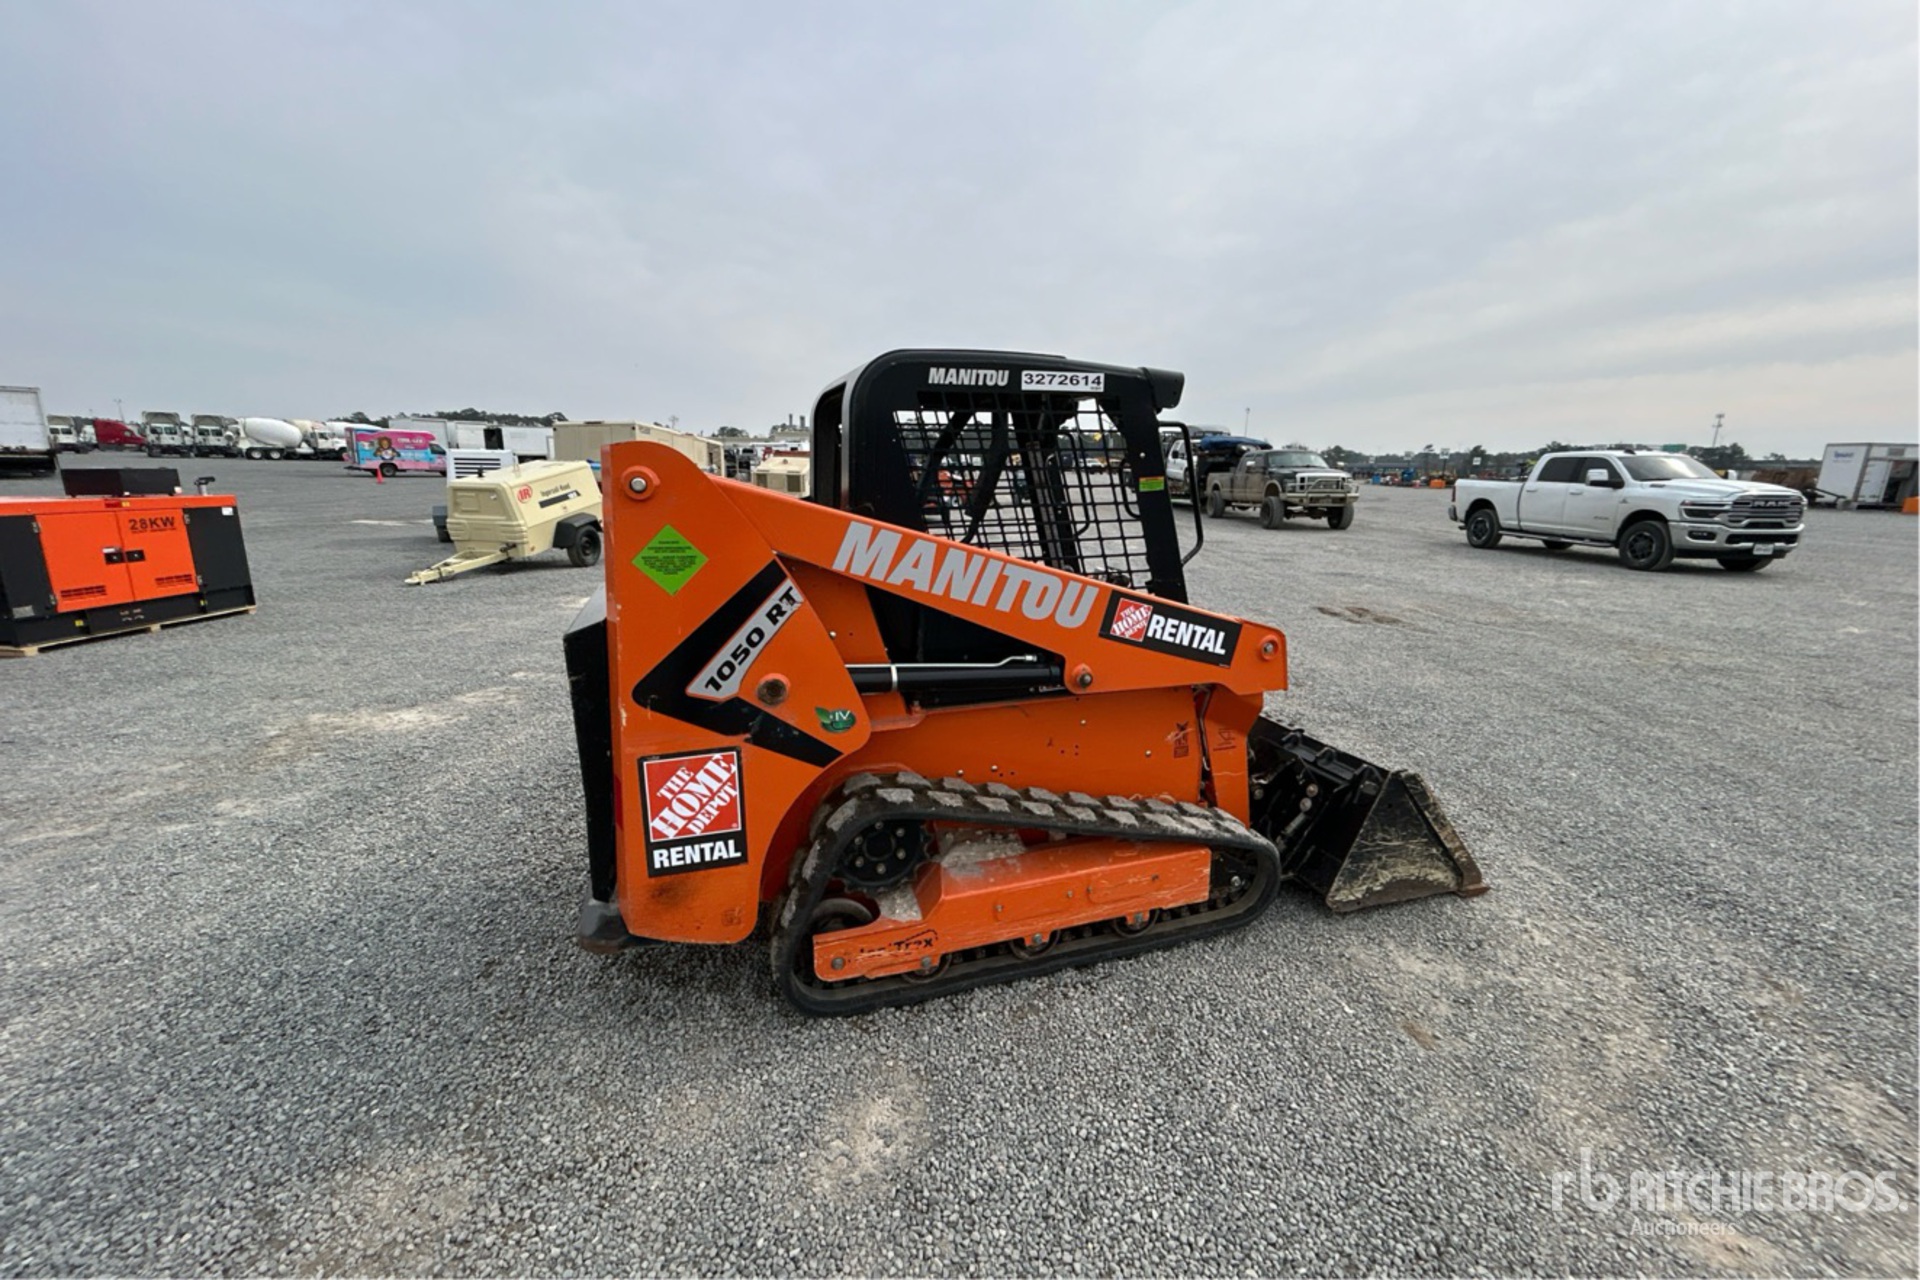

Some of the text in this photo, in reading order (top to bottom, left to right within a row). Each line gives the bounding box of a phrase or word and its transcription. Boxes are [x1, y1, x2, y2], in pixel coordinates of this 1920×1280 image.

[928, 367, 1009, 386] MANITOU
[1023, 373, 1102, 387] 3272614
[518, 488, 531, 500] IR
[129, 516, 175, 530] 28KW
[832, 520, 1099, 629] MANITOU
[1112, 604, 1151, 637] HOME
[1147, 613, 1226, 655] RENTAL
[705, 586, 797, 692] 1050 RT
[651, 754, 737, 838] HOME
[656, 766, 694, 800] THE
[686, 782, 738, 835] DEPOT
[653, 839, 742, 869] RENTAL
